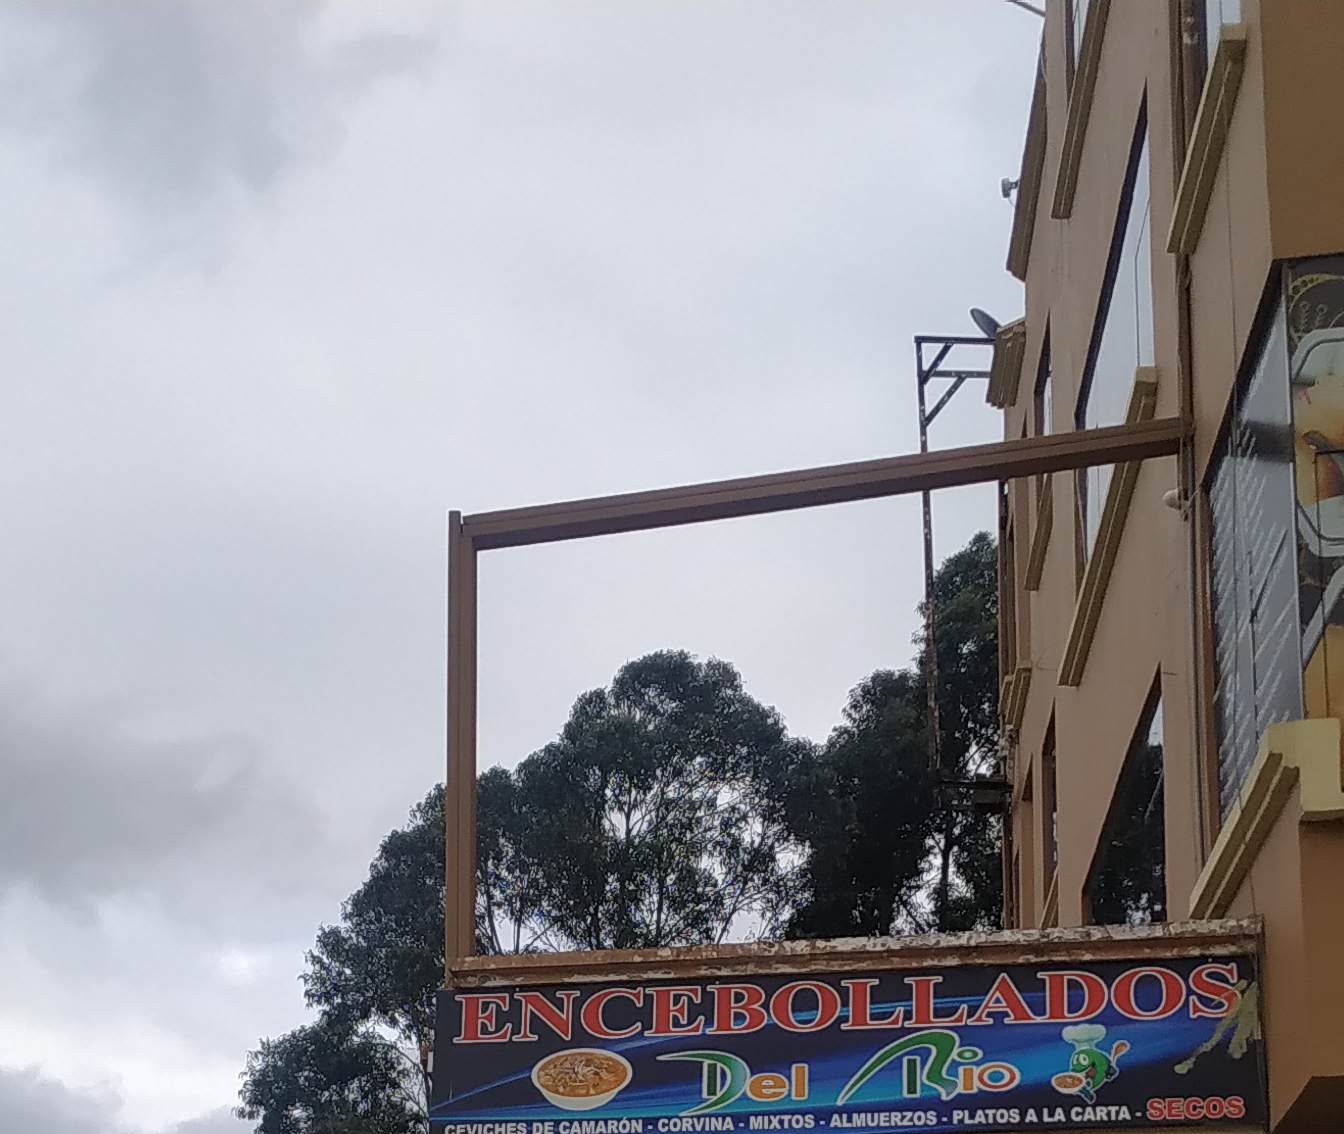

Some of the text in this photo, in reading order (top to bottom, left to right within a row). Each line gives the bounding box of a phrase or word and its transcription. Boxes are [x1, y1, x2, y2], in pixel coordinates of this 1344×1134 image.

[454, 963, 1244, 1043] ENCEBOLLADOS
[655, 1029, 1022, 1116] Del Rio
[657, 1117, 735, 1134] CORVINA
[749, 1114, 815, 1131] MIXTOS
[830, 1110, 938, 1128] ALMUERZOS
[952, 1107, 1021, 1125] PLATOS
[1024, 1106, 1039, 1122] A
[1043, 1106, 1067, 1122] LA
[1070, 1104, 1132, 1122] CARTA
[1146, 1096, 1247, 1121] SECOS
